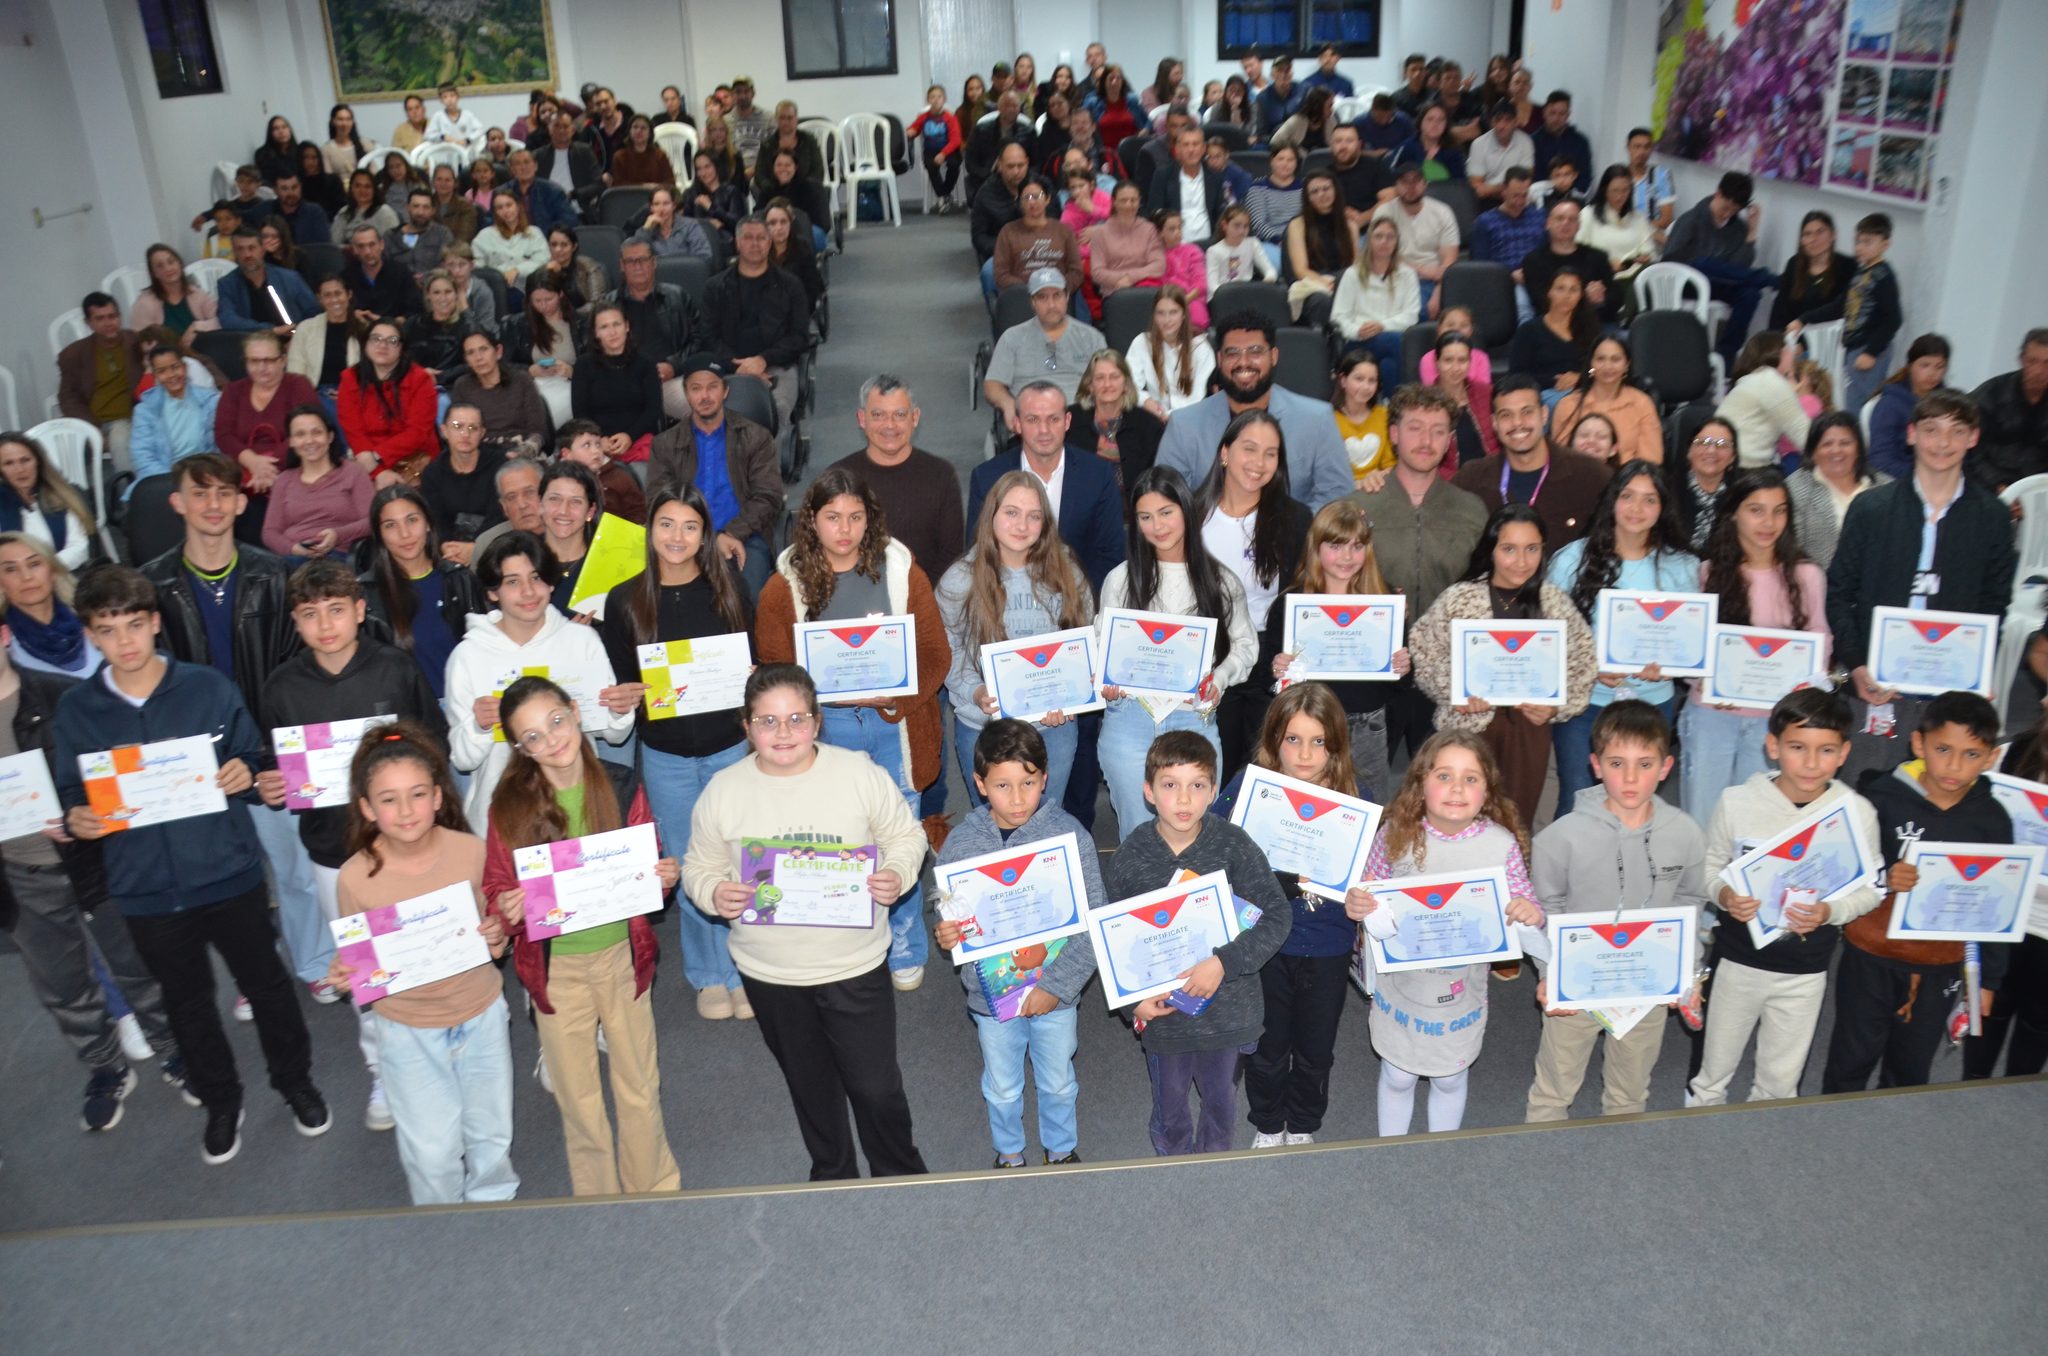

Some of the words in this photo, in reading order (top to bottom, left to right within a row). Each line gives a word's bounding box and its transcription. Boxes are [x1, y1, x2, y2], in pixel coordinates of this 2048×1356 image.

[837, 650, 877, 659] CERTIFICATE
[1138, 645, 1175, 655] CERTIFICATE
[1025, 668, 1062, 680] CERTIFICATE
[1280, 819, 1325, 837] CERTIFICATE
[783, 858, 864, 872] CERTIFICATE
[990, 885, 1036, 901] CERTIFICATE
[1414, 911, 1462, 921] CERTIFICATE
[1144, 926, 1189, 944] CERTIFICATE
[1597, 951, 1644, 960] CERTIFICATE
[1414, 1018, 1446, 1037] THE
